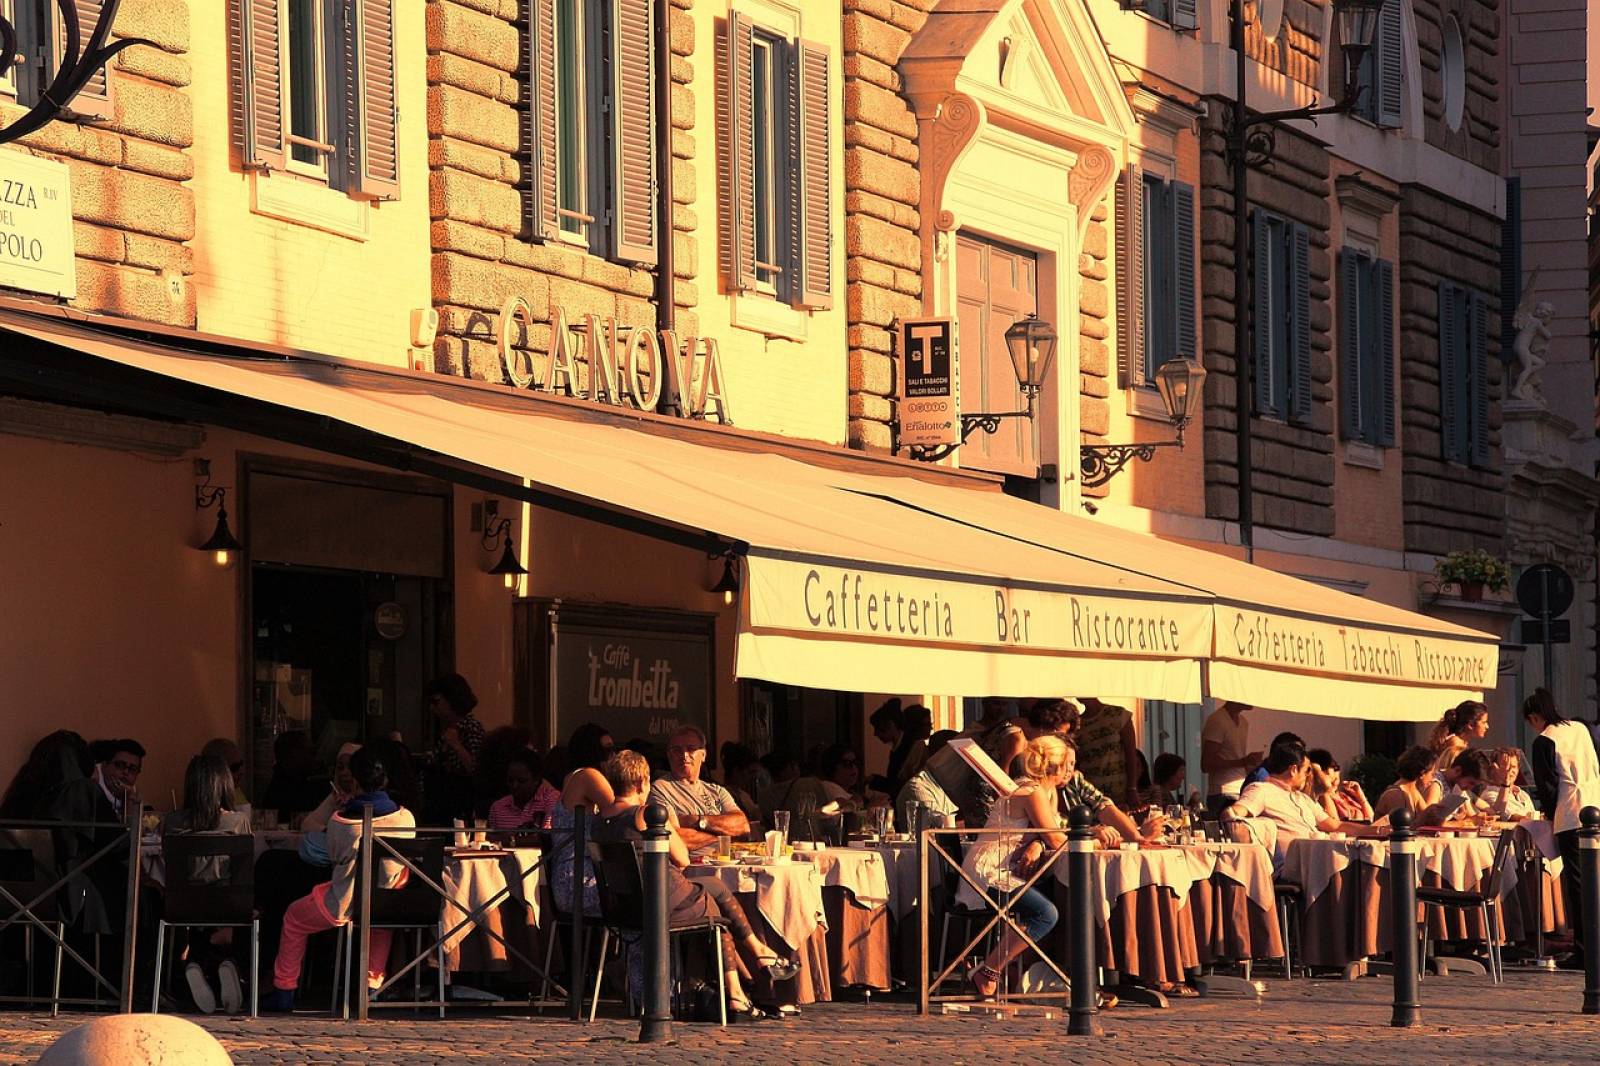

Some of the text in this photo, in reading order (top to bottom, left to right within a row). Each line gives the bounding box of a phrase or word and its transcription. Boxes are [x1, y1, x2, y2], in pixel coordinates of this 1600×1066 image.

[0, 179, 37, 209] ZZA
[500, 295, 733, 426] CANOVA
[911, 326, 943, 374] T
[804, 569, 1180, 652] Caffetteria Bar Ristorante
[603, 644, 631, 669] Caffè
[1233, 612, 1485, 684] Caffetteria Tabacchi Ristorante
[588, 655, 680, 709] trombetta
